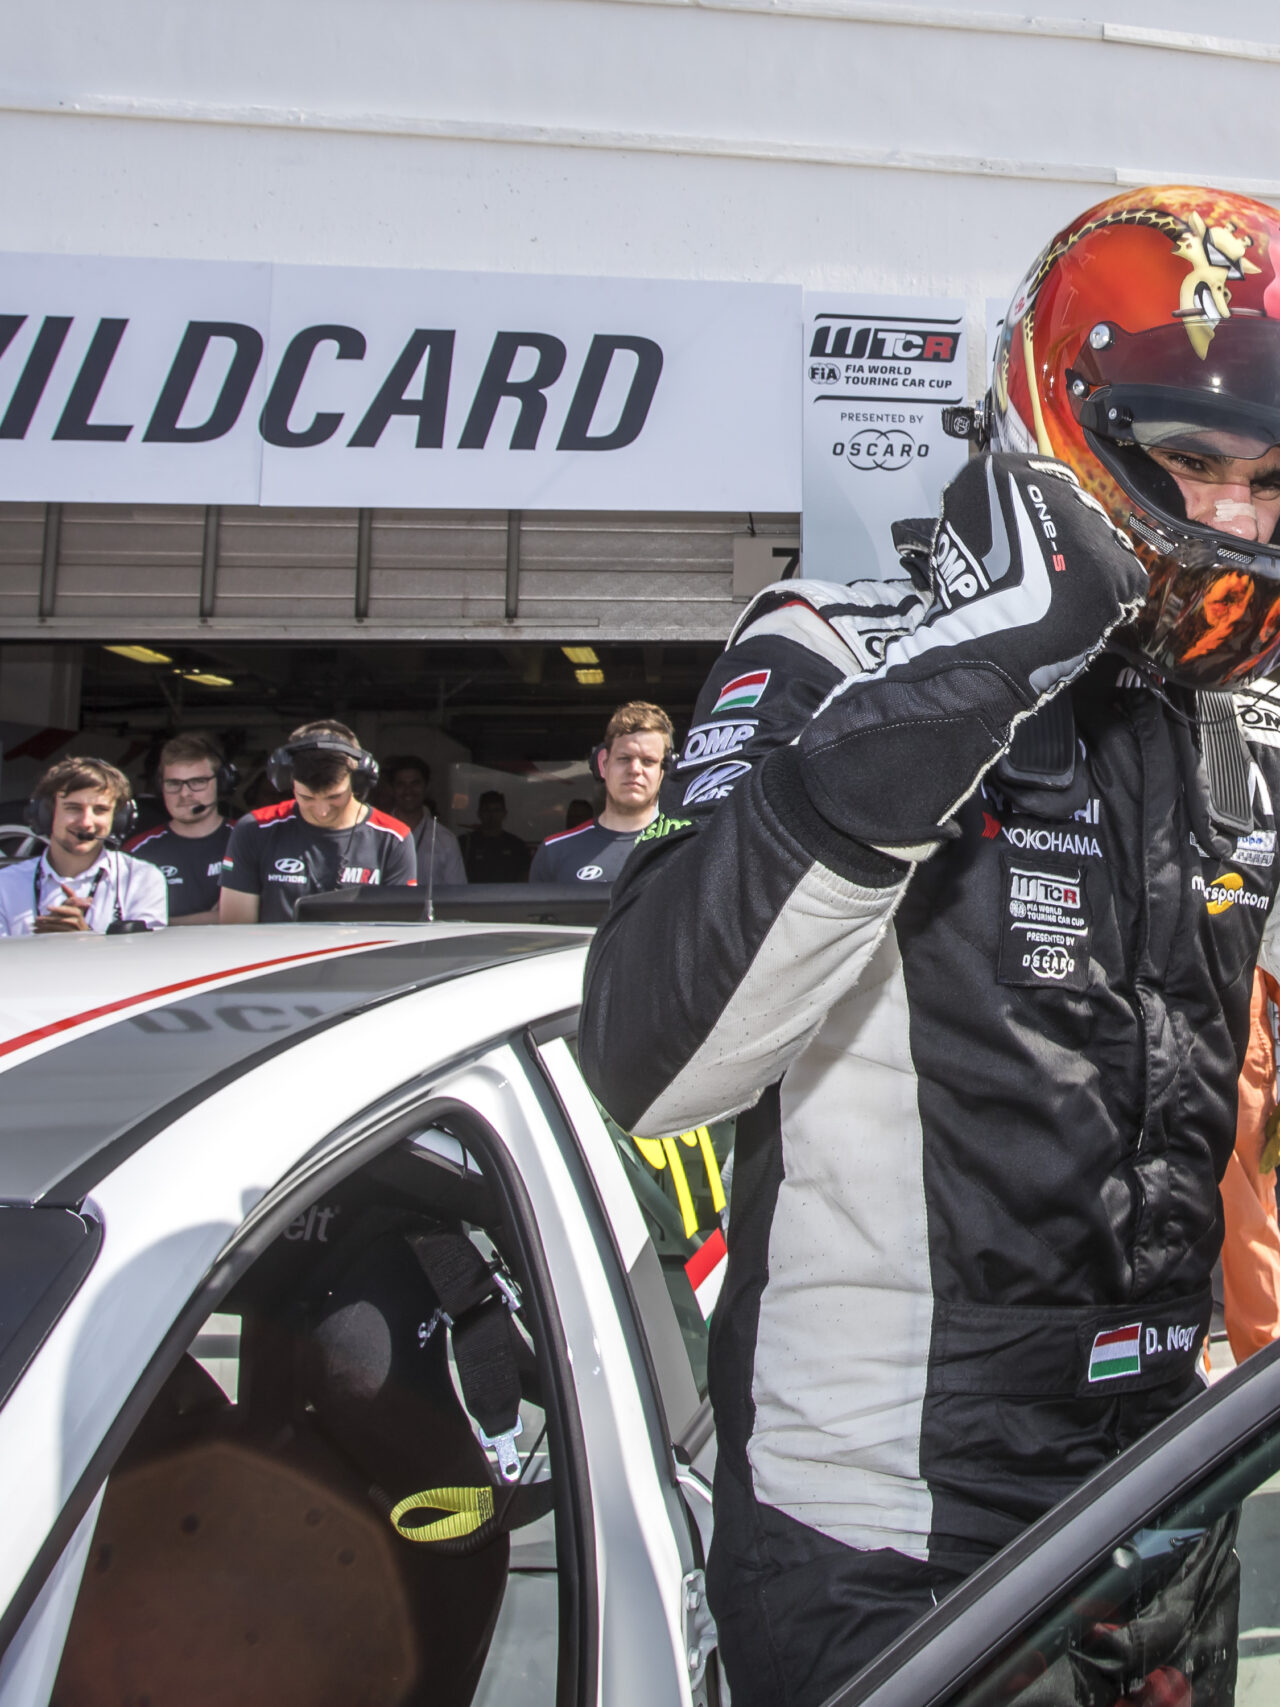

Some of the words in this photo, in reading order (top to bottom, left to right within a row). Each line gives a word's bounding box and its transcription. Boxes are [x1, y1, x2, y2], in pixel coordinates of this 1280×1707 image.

[810, 325, 962, 363] WTCR
[845, 364, 866, 374] FIA
[868, 365, 911, 375] WORLD
[845, 376, 898, 387] TOURING
[902, 378, 925, 388] CAR
[929, 379, 952, 389] CUP
[841, 412, 905, 423] PRESENTED
[910, 414, 924, 424] BY
[832, 442, 930, 458] OSCARO
[772, 547, 800, 581] 7
[937, 532, 979, 599] OMP
[684, 725, 756, 761] OMP
[1002, 826, 1103, 858] YOKOHAMA
[1010, 875, 1081, 909] WTCR
[1039, 904, 1062, 915] WORLD
[1027, 912, 1056, 923] TOURING
[1058, 916, 1070, 925] CAR
[1071, 918, 1084, 927] CUP
[1027, 932, 1065, 945] PRESENTED
[1066, 937, 1075, 946] BY
[1022, 954, 1075, 972] OSCARO
[1145, 1327, 1163, 1356] D.
